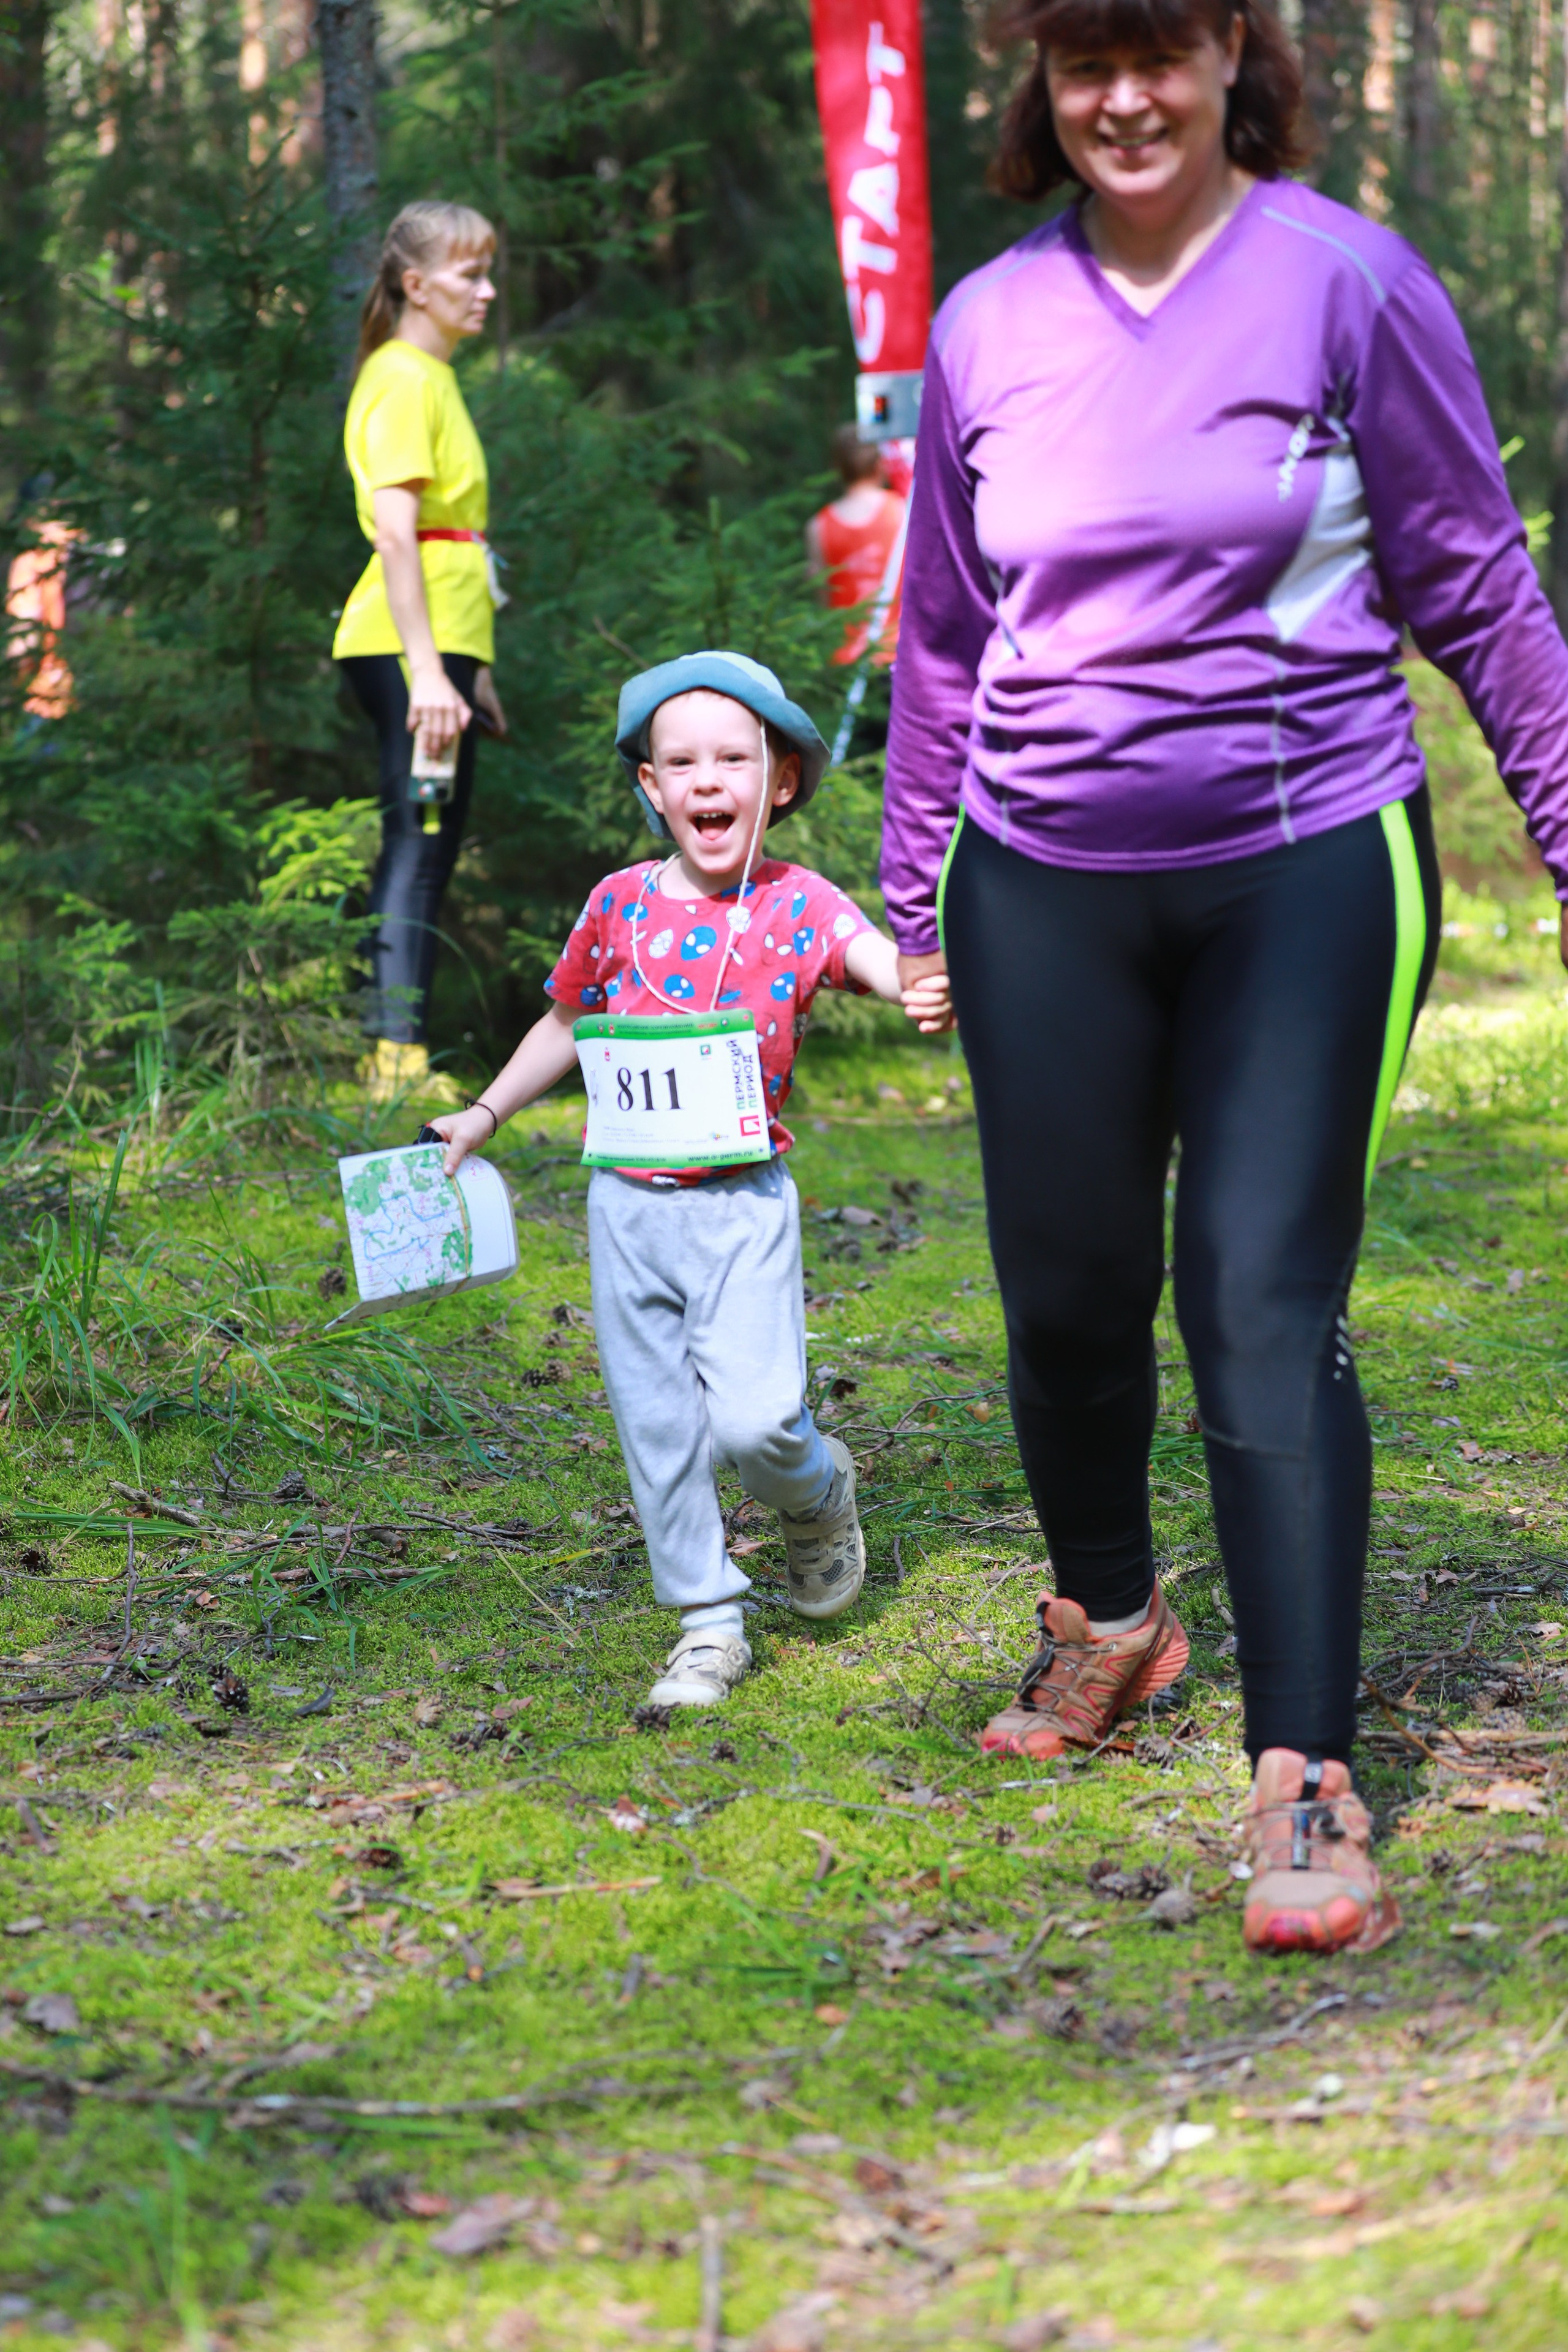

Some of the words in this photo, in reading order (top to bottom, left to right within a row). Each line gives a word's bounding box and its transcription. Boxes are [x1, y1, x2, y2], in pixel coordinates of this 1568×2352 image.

[617, 1067, 682, 1112] 811
[726, 1039, 745, 1109] ПЕРМСКИЙ
[743, 1055, 758, 1107] ПЕРИОД
